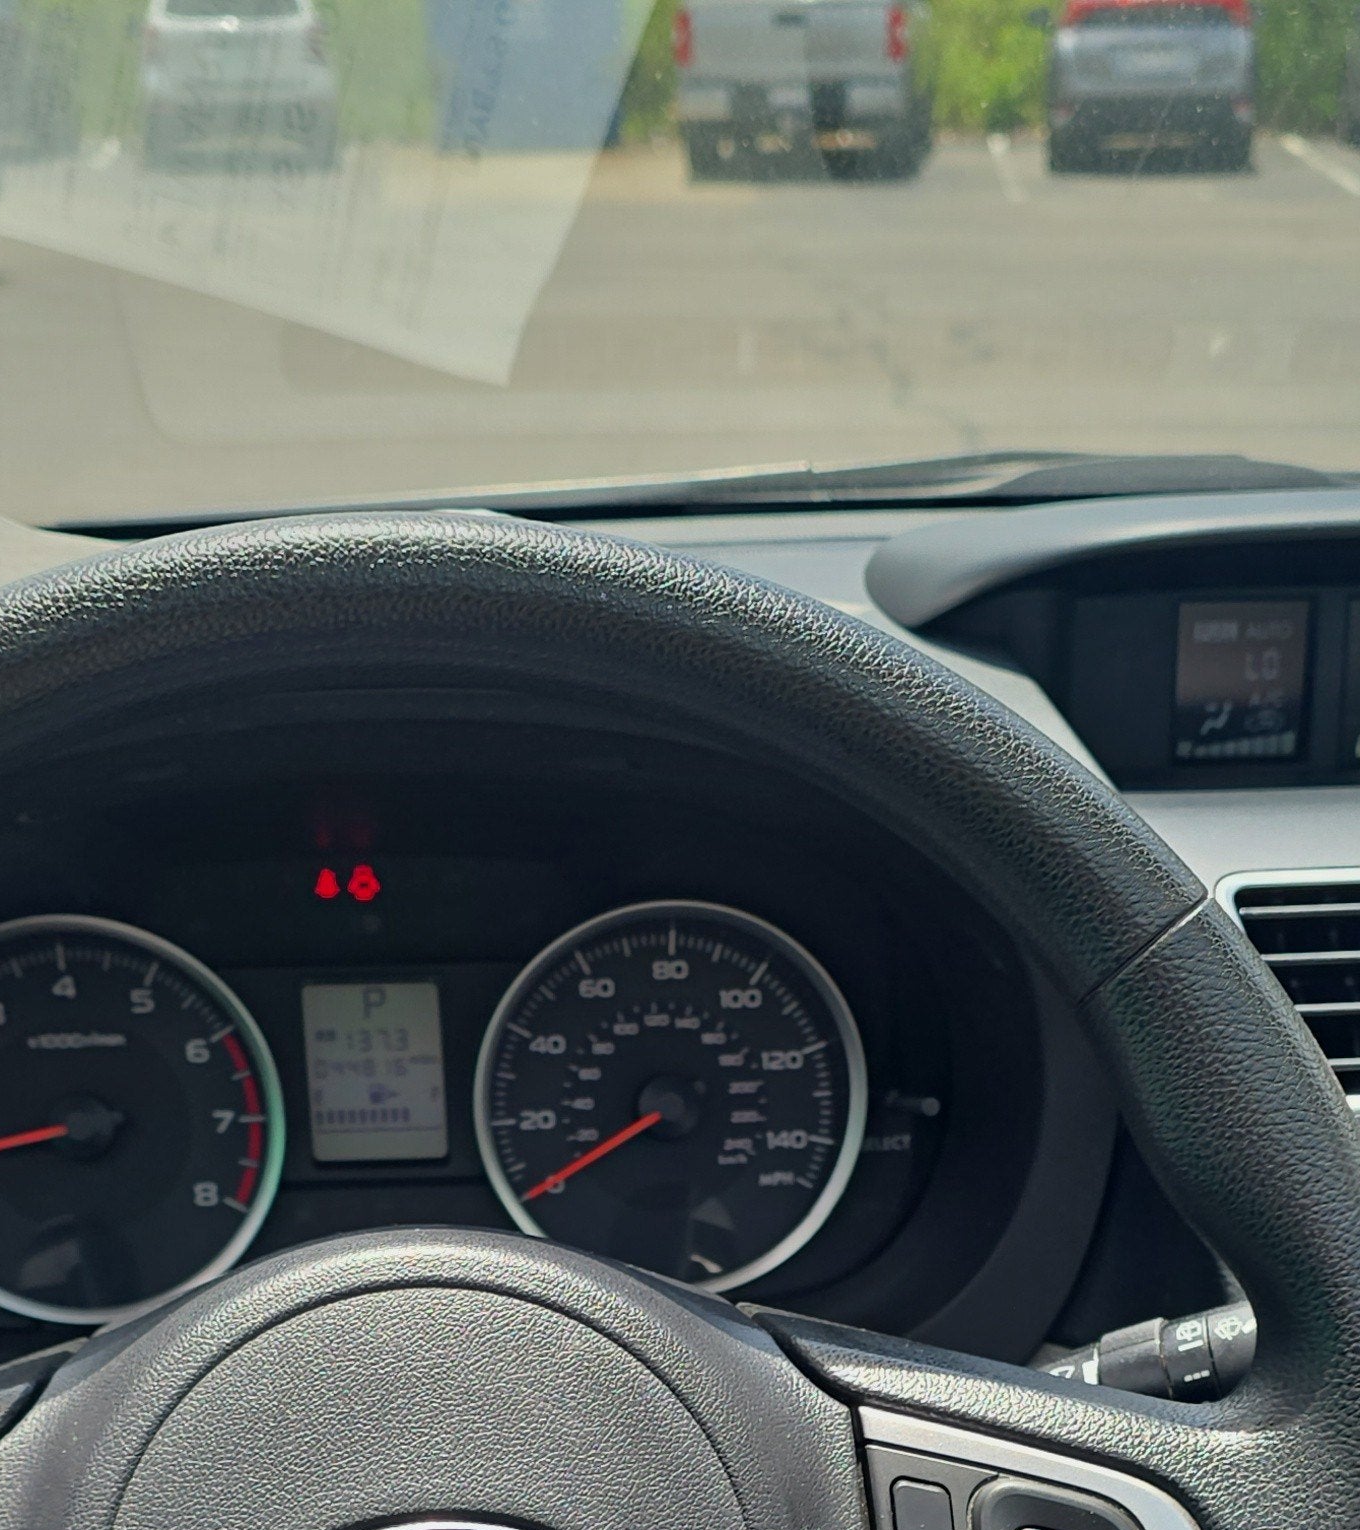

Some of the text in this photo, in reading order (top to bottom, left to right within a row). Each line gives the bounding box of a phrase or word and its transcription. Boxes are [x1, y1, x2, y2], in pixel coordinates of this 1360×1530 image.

[652, 959, 689, 980] 80
[51, 976, 77, 998] 4
[578, 978, 615, 998] 60
[130, 989, 154, 1013] 5
[361, 986, 386, 1018] P
[719, 989, 762, 1008] 100
[185, 1039, 209, 1063] 6
[529, 1034, 567, 1054] 40
[761, 1050, 803, 1070] 120
[212, 1110, 235, 1134] 7
[519, 1109, 556, 1130] 20
[766, 1130, 809, 1150] 140
[193, 1182, 218, 1206] 8
